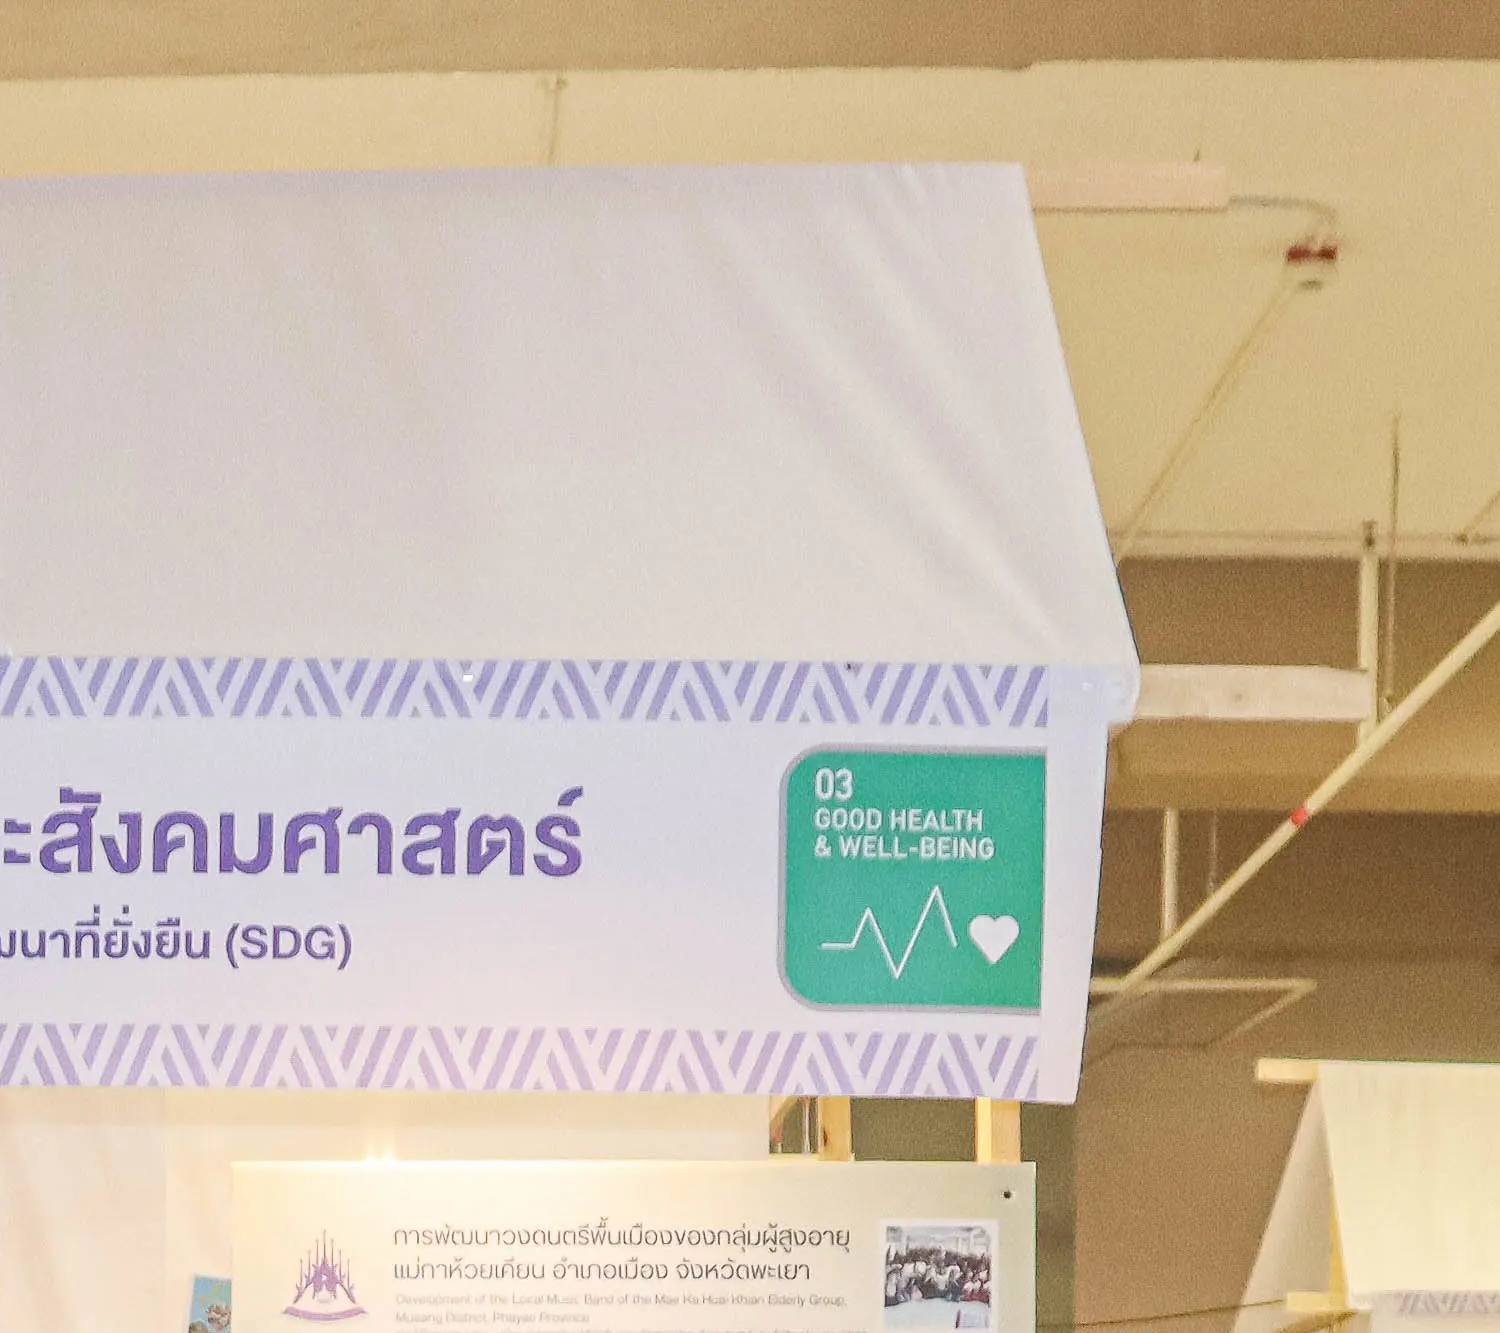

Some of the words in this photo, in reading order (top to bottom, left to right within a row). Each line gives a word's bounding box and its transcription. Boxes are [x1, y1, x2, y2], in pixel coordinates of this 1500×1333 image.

[814, 767, 854, 800] 03
[814, 808, 882, 830] GOOD
[890, 809, 983, 832] HEALTH
[814, 835, 832, 857] &
[839, 836, 995, 860] WELL-BEING
[225, 923, 353, 970] (SDG)
[393, 1217, 851, 1253] การพัฒนาวงดนตรีพื้นเมืองของกลุ่มผู้สูงอายุ
[393, 1256, 545, 1281] แม่กาห้วยเคียน
[552, 1257, 669, 1281] อำเภอเมือง
[677, 1256, 811, 1281] จังหวัดพะเยา
